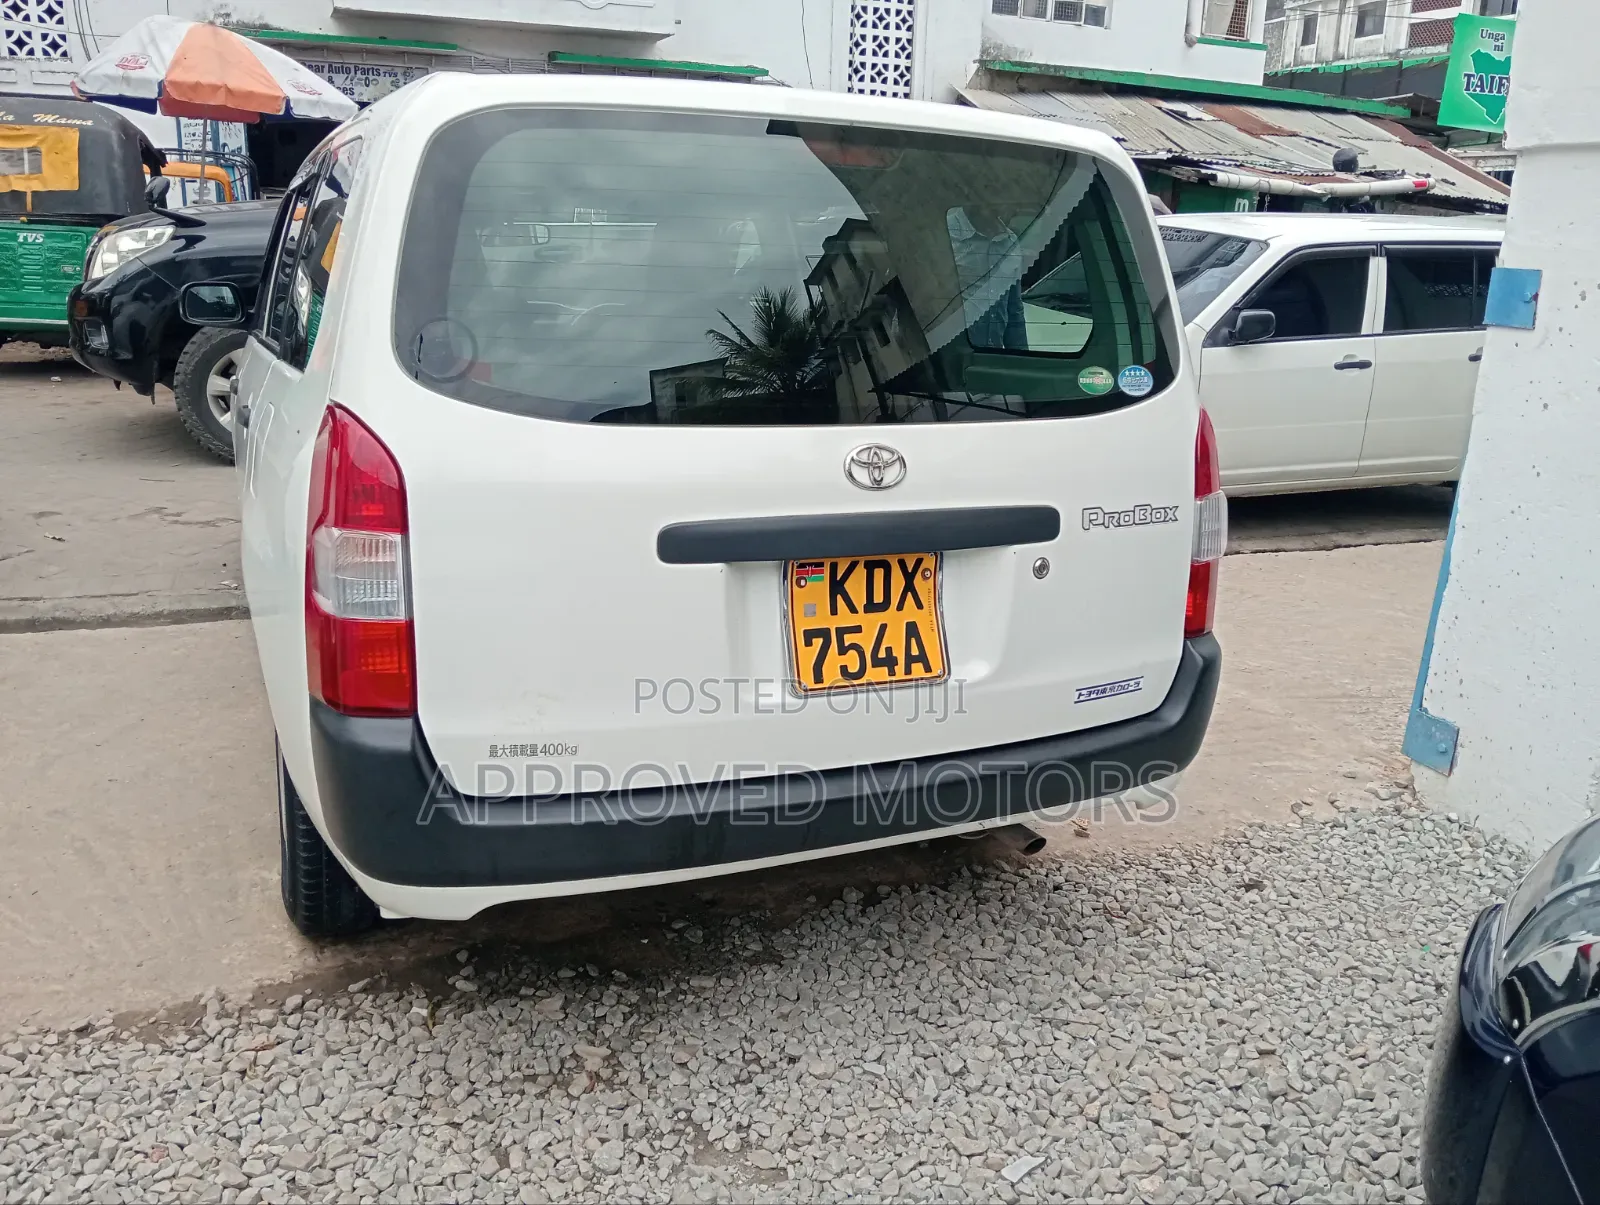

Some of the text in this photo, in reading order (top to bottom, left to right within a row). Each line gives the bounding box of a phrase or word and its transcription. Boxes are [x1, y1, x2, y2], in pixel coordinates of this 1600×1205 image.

[1480, 28, 1506, 43] Unga
[1493, 42, 1504, 52] ni
[327, 64, 352, 75] Auto
[354, 64, 381, 77] Parts
[1463, 73, 1511, 96] TAIF
[33, 113, 94, 126] Mama
[17, 232, 45, 243] TVS
[829, 557, 924, 616] KDX
[803, 620, 933, 684] 754A
